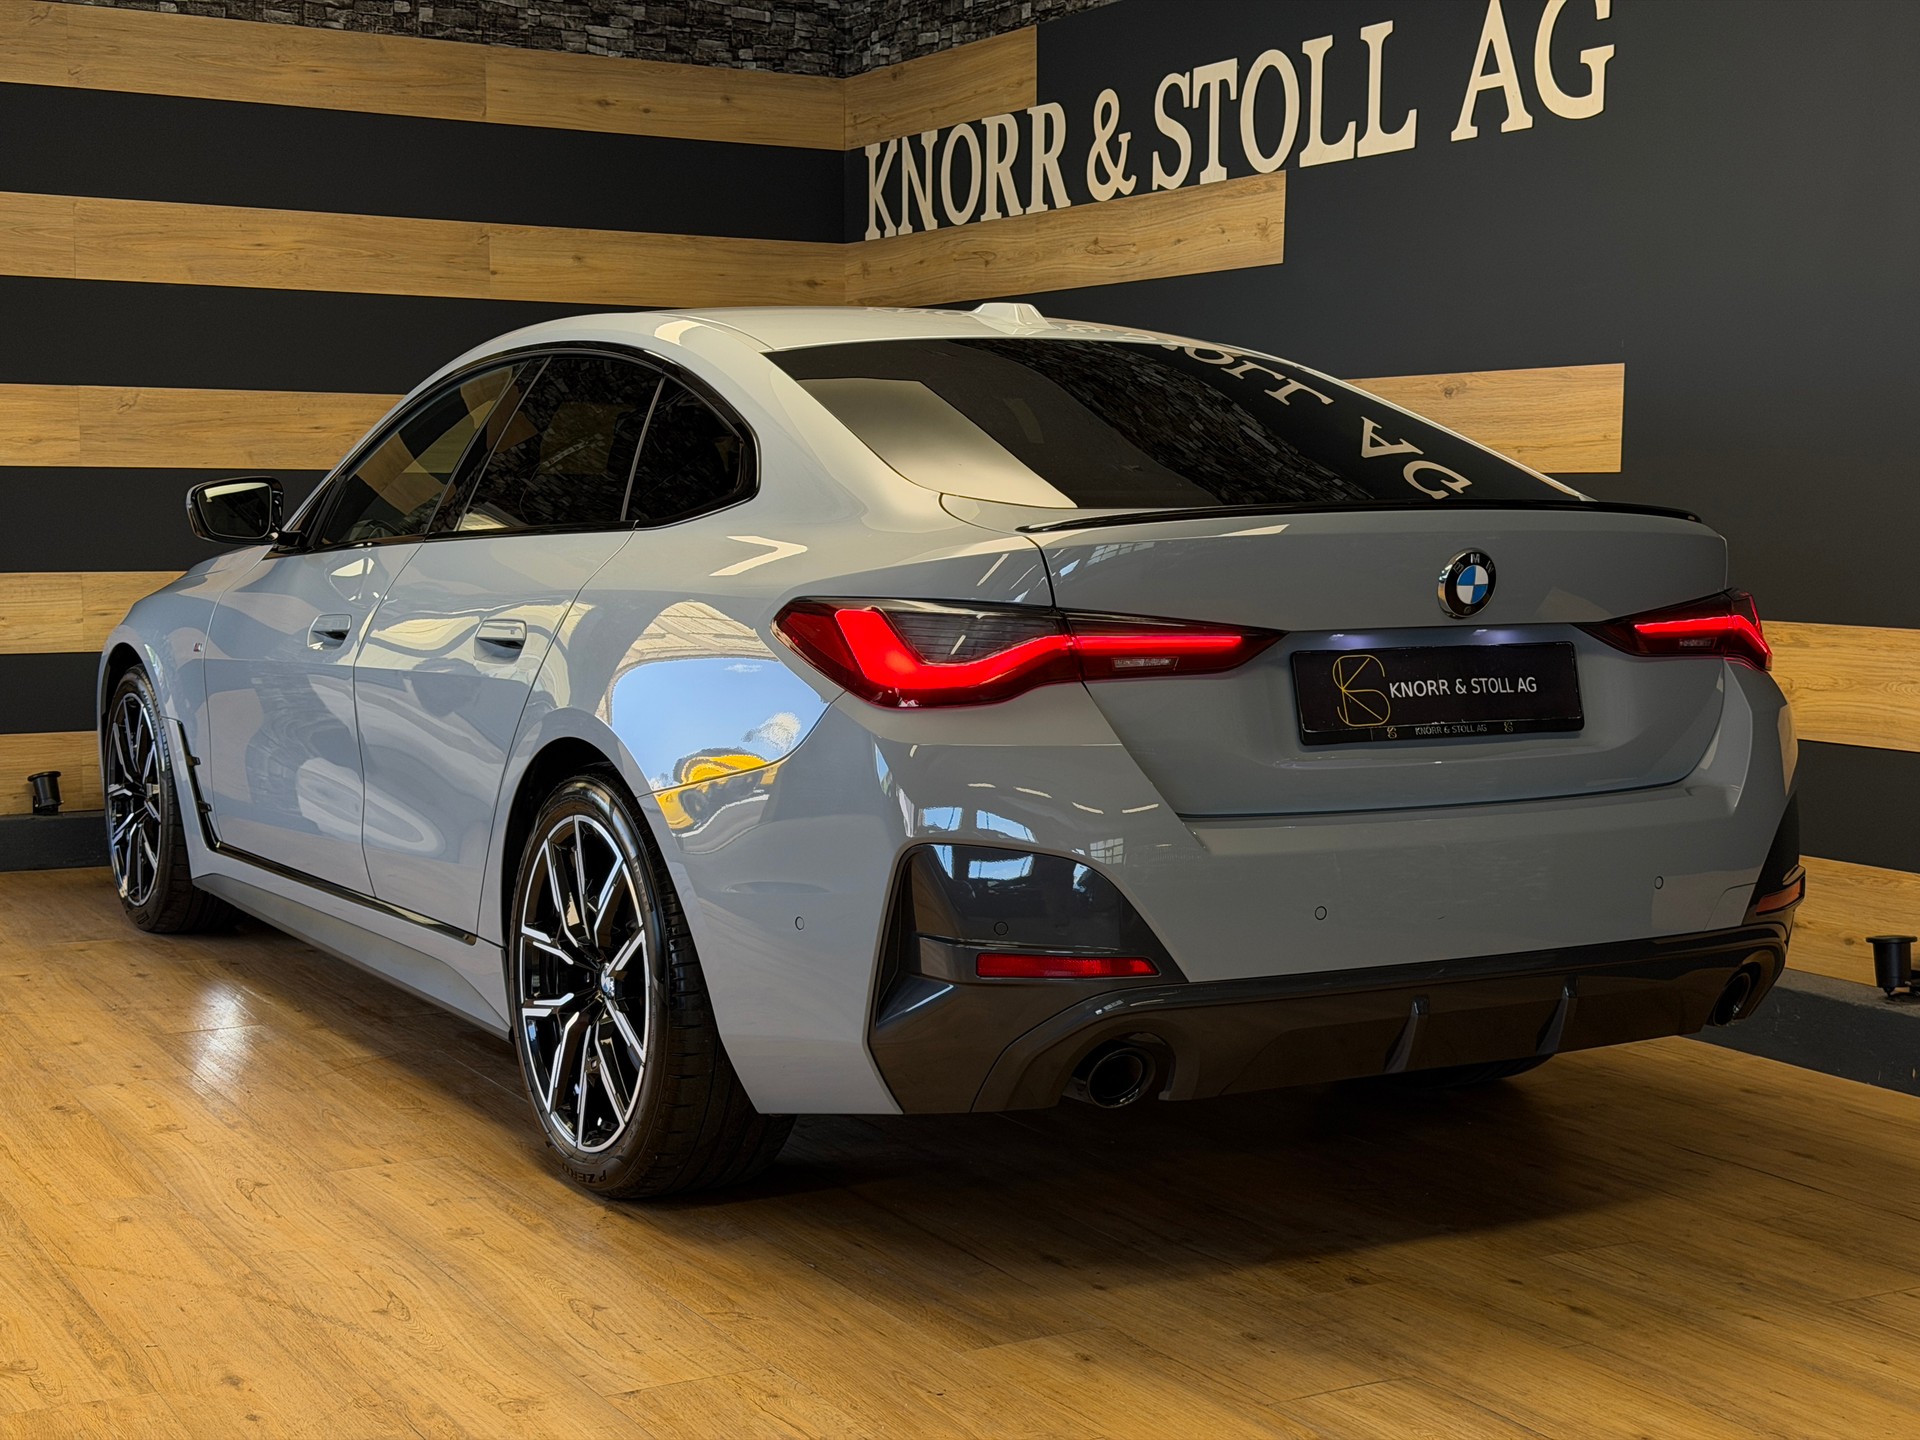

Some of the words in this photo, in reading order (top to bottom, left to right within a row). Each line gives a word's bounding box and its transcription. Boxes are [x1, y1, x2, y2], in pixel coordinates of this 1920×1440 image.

[865, 102, 1071, 241] KNORR
[1087, 88, 1136, 201] &
[1152, 20, 1417, 191] STOLL
[1450, 0, 1615, 142] AG
[1453, 553, 1495, 574] BMW
[1389, 678, 1450, 698] KNORR
[1455, 679, 1467, 694] &
[1471, 677, 1514, 694] STOLL
[1517, 676, 1538, 693] AG
[1415, 725, 1442, 736] KNORR
[1444, 725, 1451, 734] &
[1451, 724, 1475, 734] STOLL
[1477, 723, 1488, 733] AG
